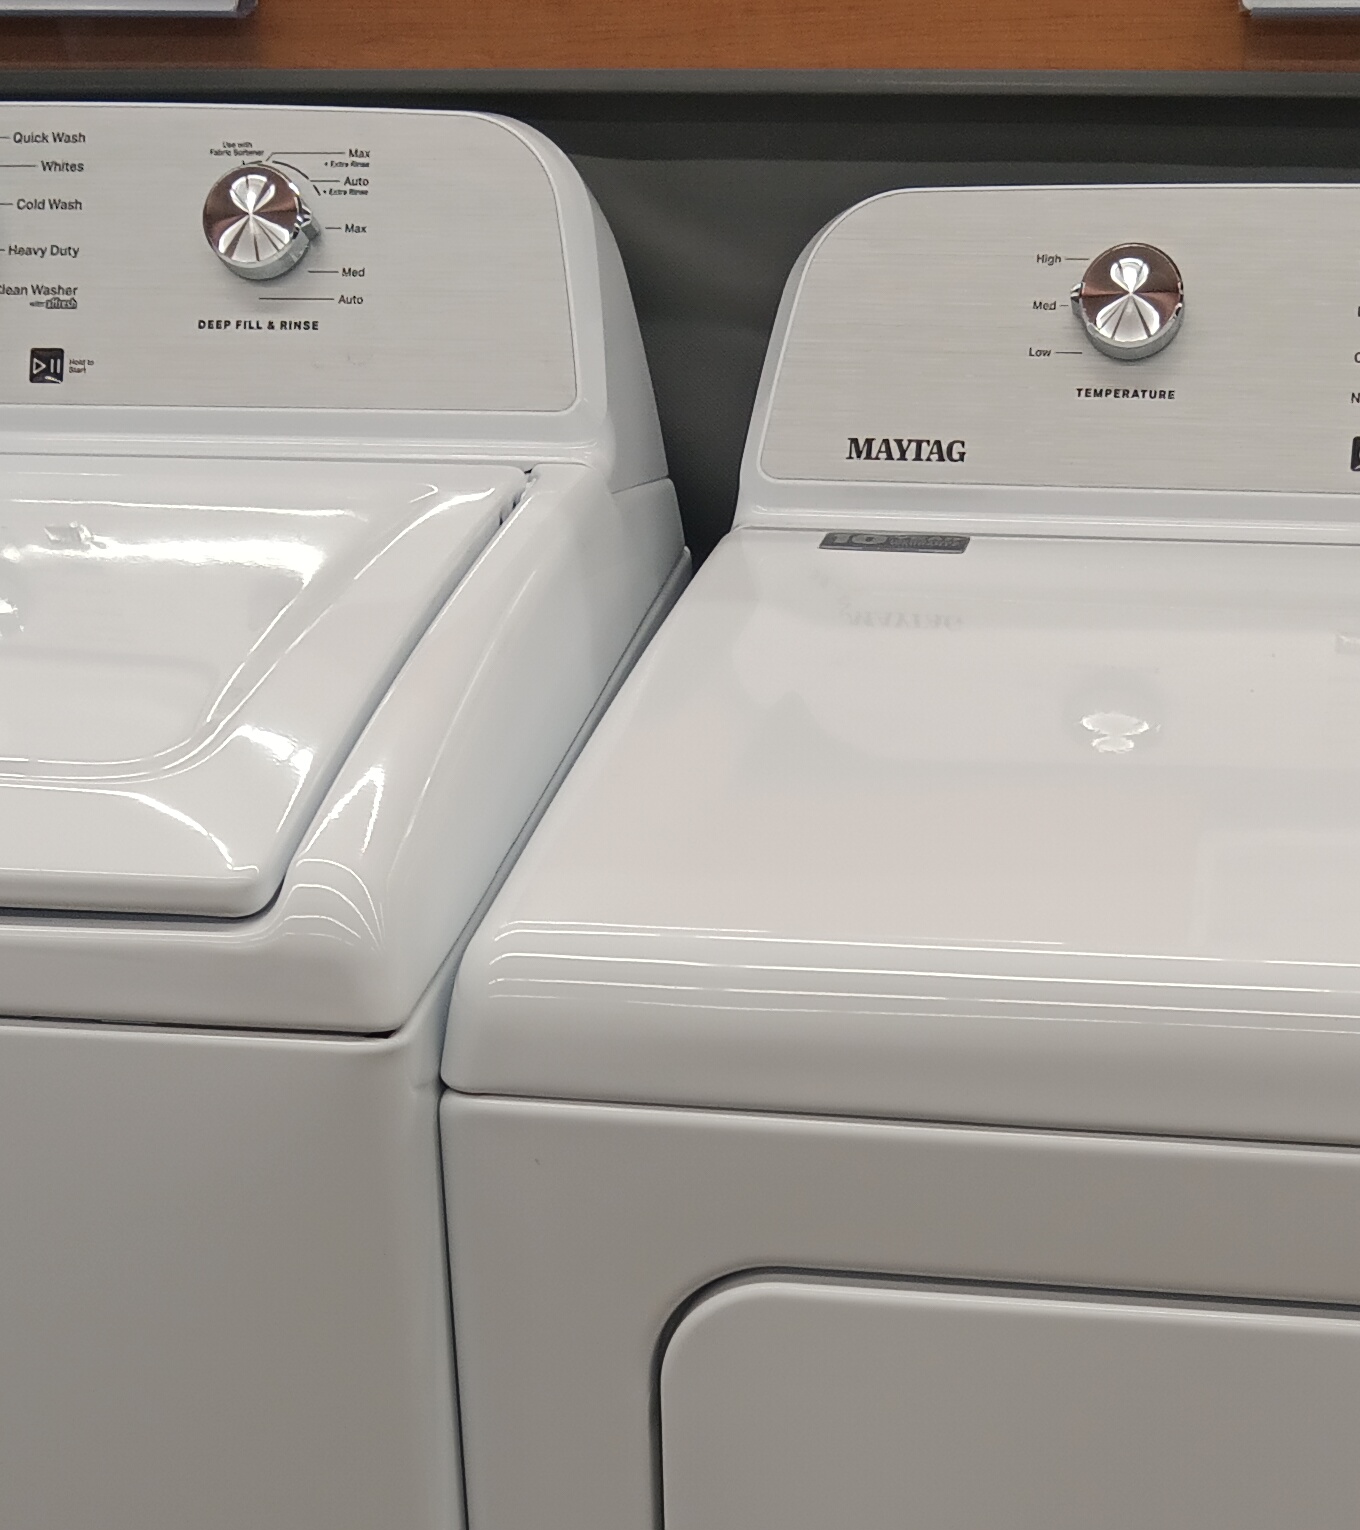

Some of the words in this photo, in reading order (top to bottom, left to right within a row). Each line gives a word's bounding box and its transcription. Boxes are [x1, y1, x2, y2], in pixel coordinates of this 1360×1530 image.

[13, 132, 48, 144] Quick
[52, 132, 86, 144] Wash
[348, 149, 370, 158] Max
[41, 160, 85, 172] Whites
[344, 176, 369, 187] Auto
[16, 199, 46, 211] Cold
[49, 199, 83, 211] Wash
[345, 224, 367, 234] Max
[8, 245, 47, 258] Heavy
[50, 244, 80, 259] Duty
[1036, 253, 1062, 266] High
[342, 268, 366, 277] Med
[31, 284, 78, 296] Washer
[338, 295, 364, 306] Auto
[1032, 301, 1057, 310] Med
[197, 320, 232, 330] DEEP
[235, 320, 263, 330] FILL
[266, 320, 276, 331] &
[280, 320, 319, 331] RINSE
[1028, 347, 1052, 357] Low
[1076, 388, 1176, 399] TEMPERATURE
[846, 437, 966, 462] MAYTAG
